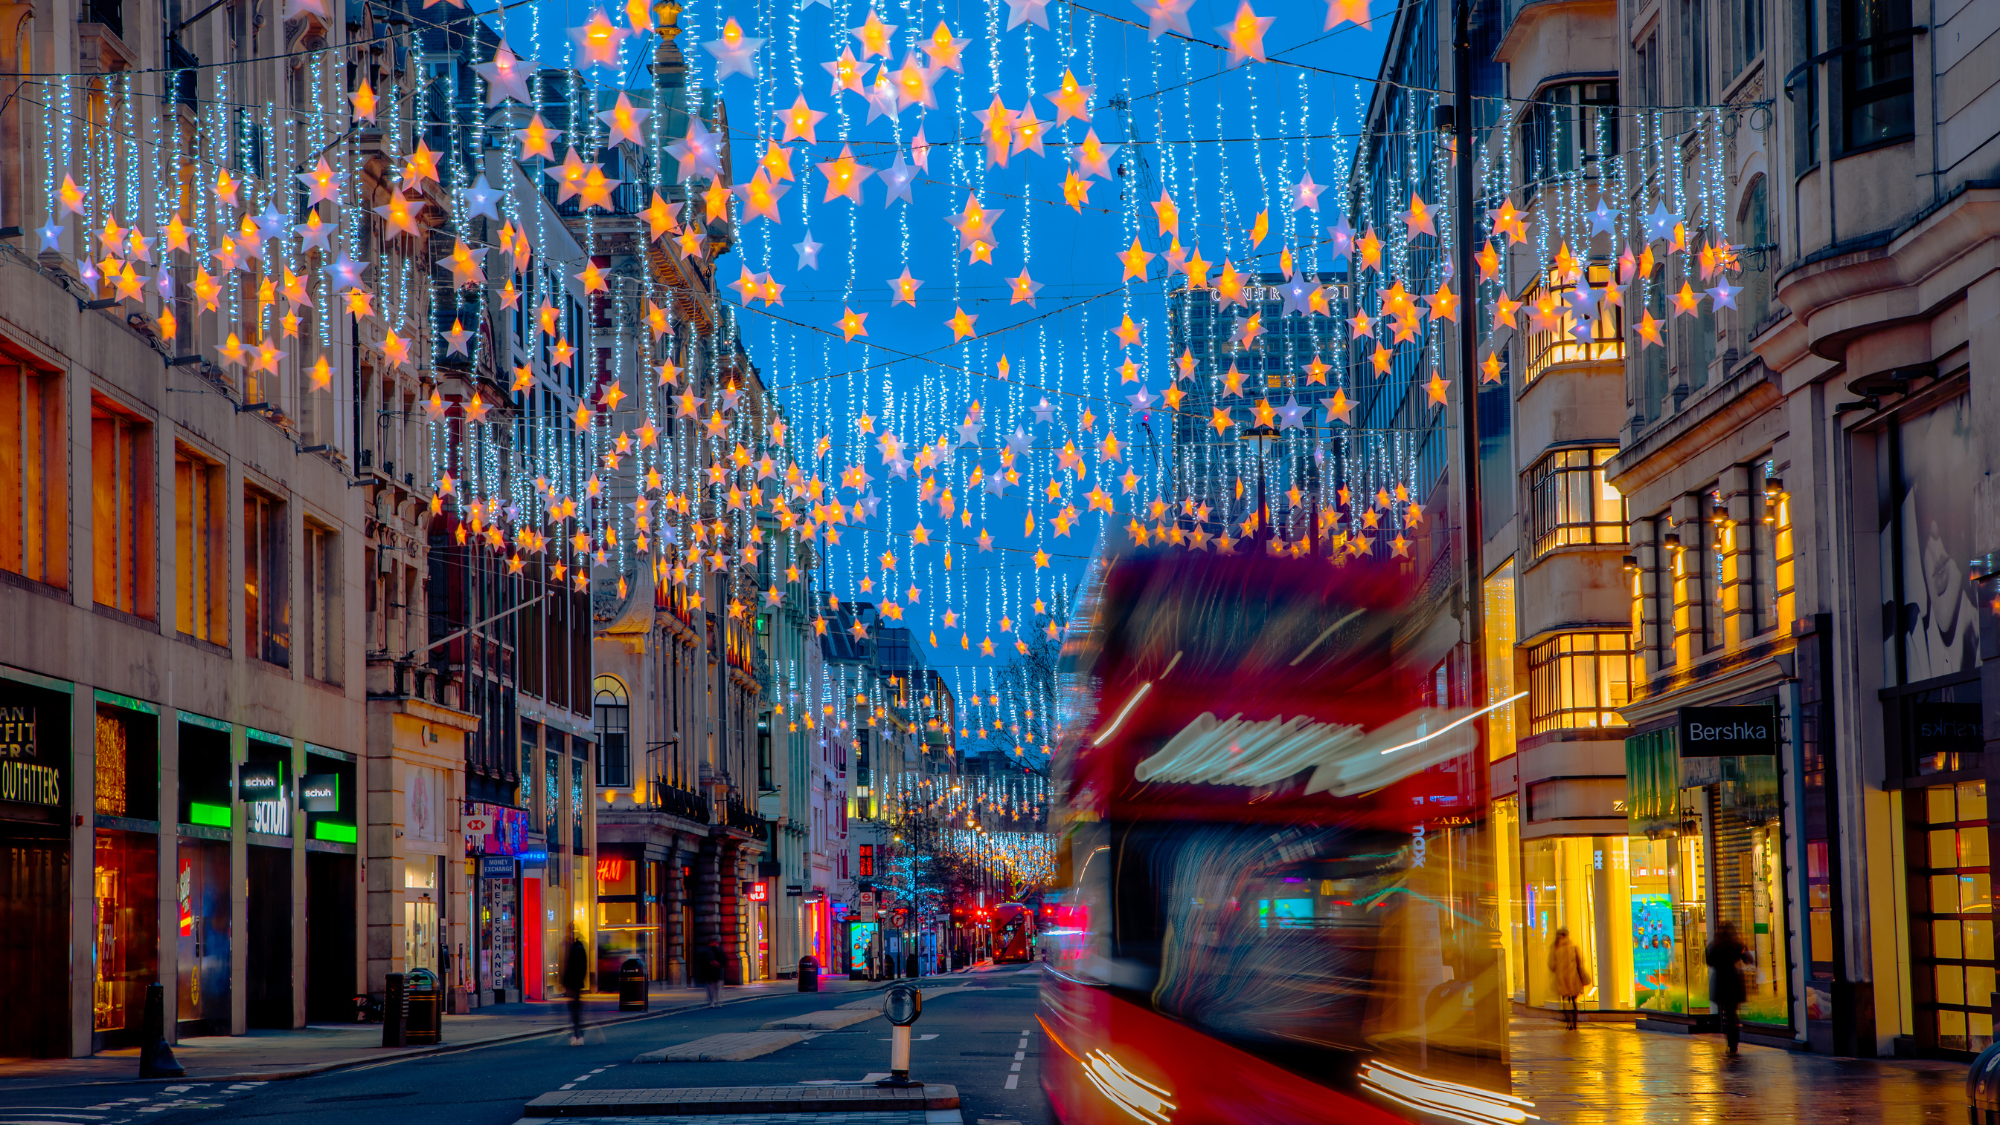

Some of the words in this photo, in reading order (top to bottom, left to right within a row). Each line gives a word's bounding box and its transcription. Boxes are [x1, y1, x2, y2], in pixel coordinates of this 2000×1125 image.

[1211, 286, 1280, 301] CNTR
[0, 723, 35, 742] FIT
[1689, 722, 1767, 741] Bershka
[3, 760, 60, 805] OUTFITTERS
[245, 777, 275, 787] schuh
[305, 789, 332, 798] schuh
[1430, 816, 1472, 825] ZARA
[494, 917, 503, 987] EXCHANGE
